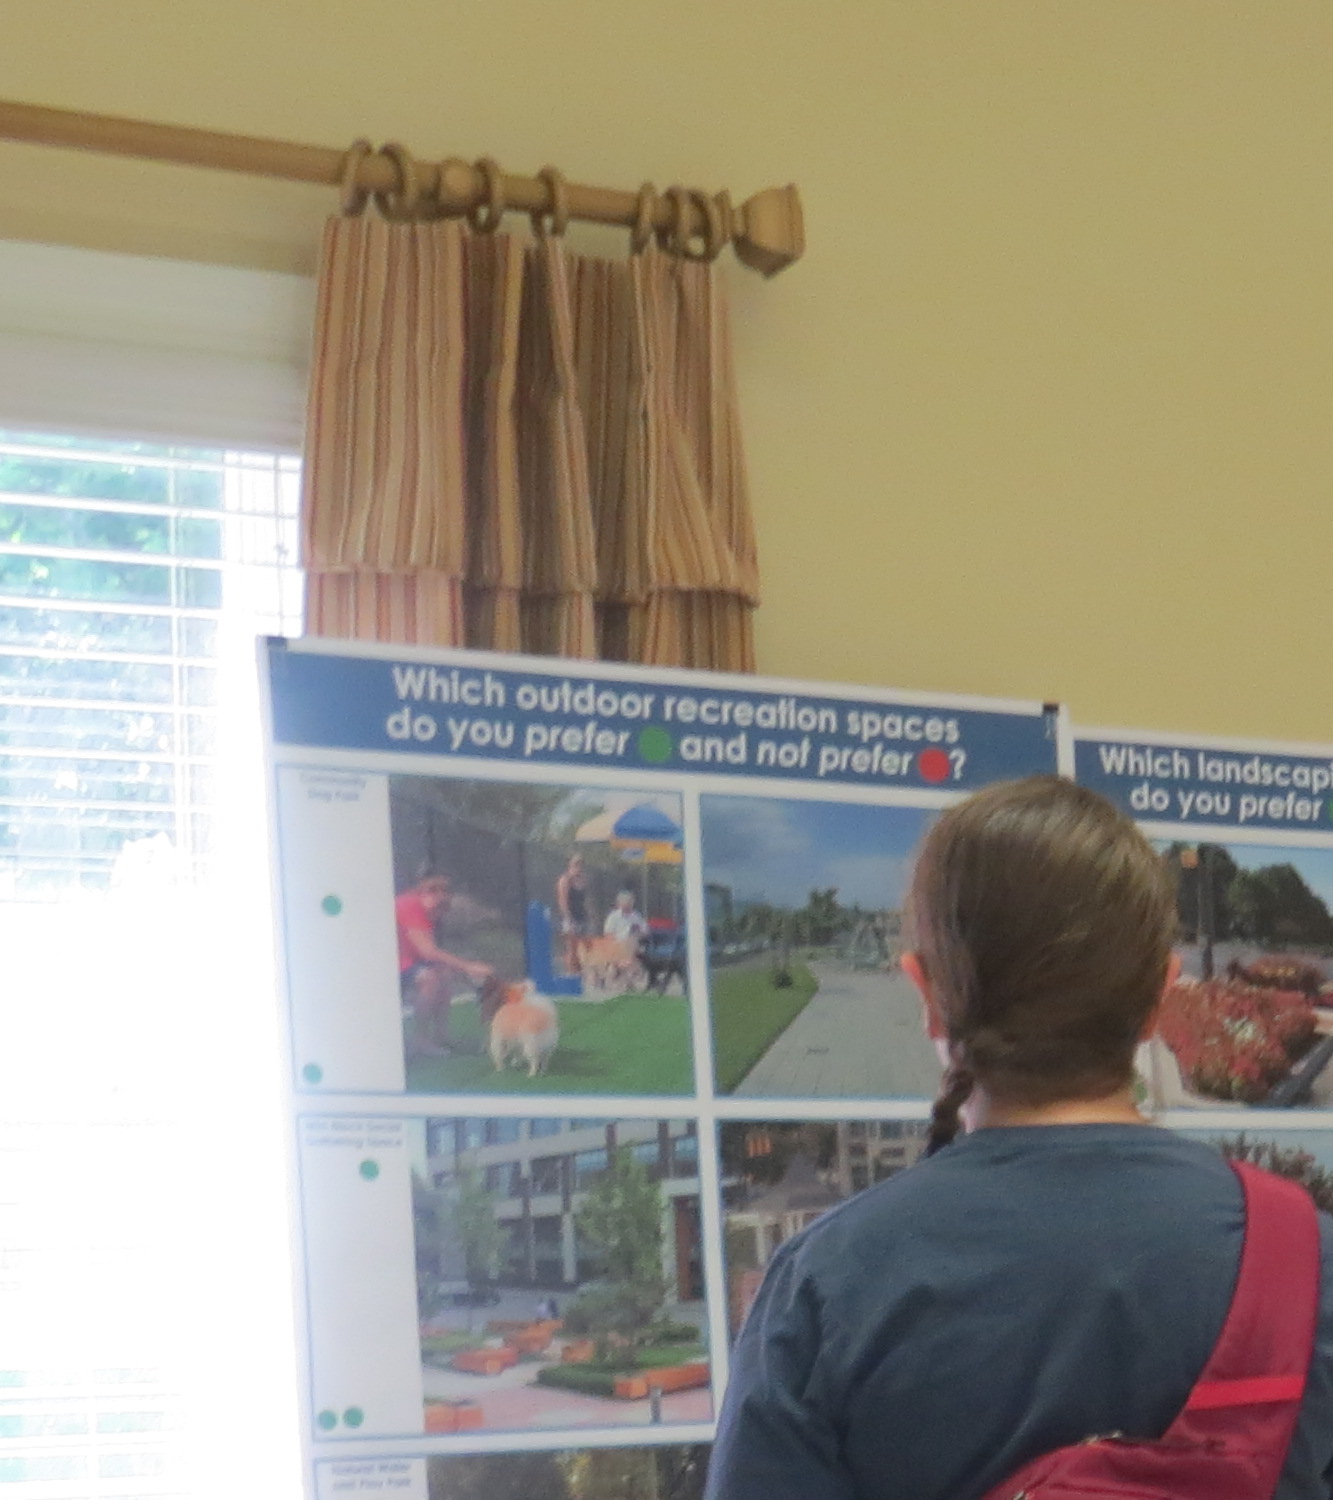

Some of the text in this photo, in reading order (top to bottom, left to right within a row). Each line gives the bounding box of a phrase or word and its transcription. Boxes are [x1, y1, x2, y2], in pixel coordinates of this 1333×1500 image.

[392, 665, 961, 744] Which outdoor recreation spaces
[386, 705, 967, 781] do you prefer and not prefer ?
[1099, 744, 1191, 779] Which
[1130, 780, 1171, 812] do
[1178, 790, 1231, 819] you
[1239, 791, 1324, 823] prefer
